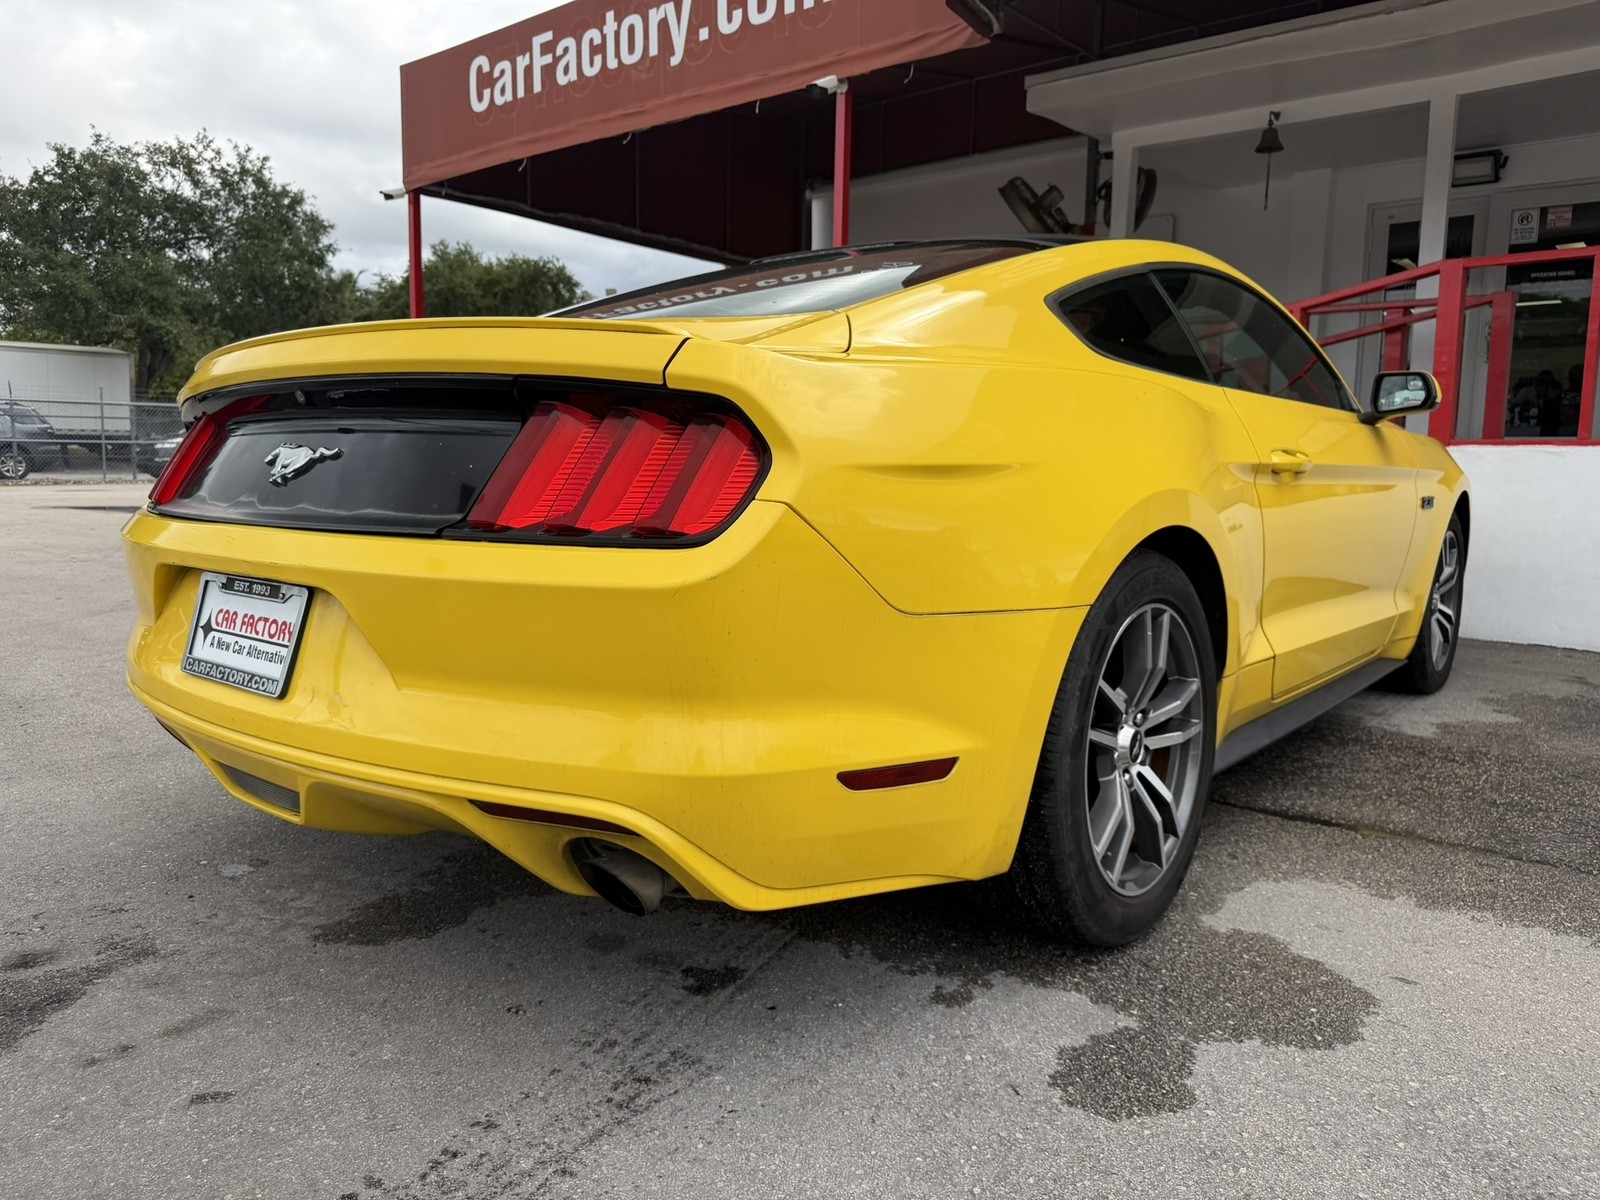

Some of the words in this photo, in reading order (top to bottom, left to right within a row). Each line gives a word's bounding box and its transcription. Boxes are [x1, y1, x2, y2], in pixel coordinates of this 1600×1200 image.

[469, 0, 832, 113] CarFactory.c
[233, 580, 250, 592] EST.
[252, 584, 271, 596] 1993
[215, 608, 239, 631] CAR
[240, 613, 295, 643] FACTORY
[209, 635, 215, 648] A
[215, 637, 231, 652] New
[232, 640, 246, 656] Car
[186, 658, 278, 694] CARFACTORY.COM
